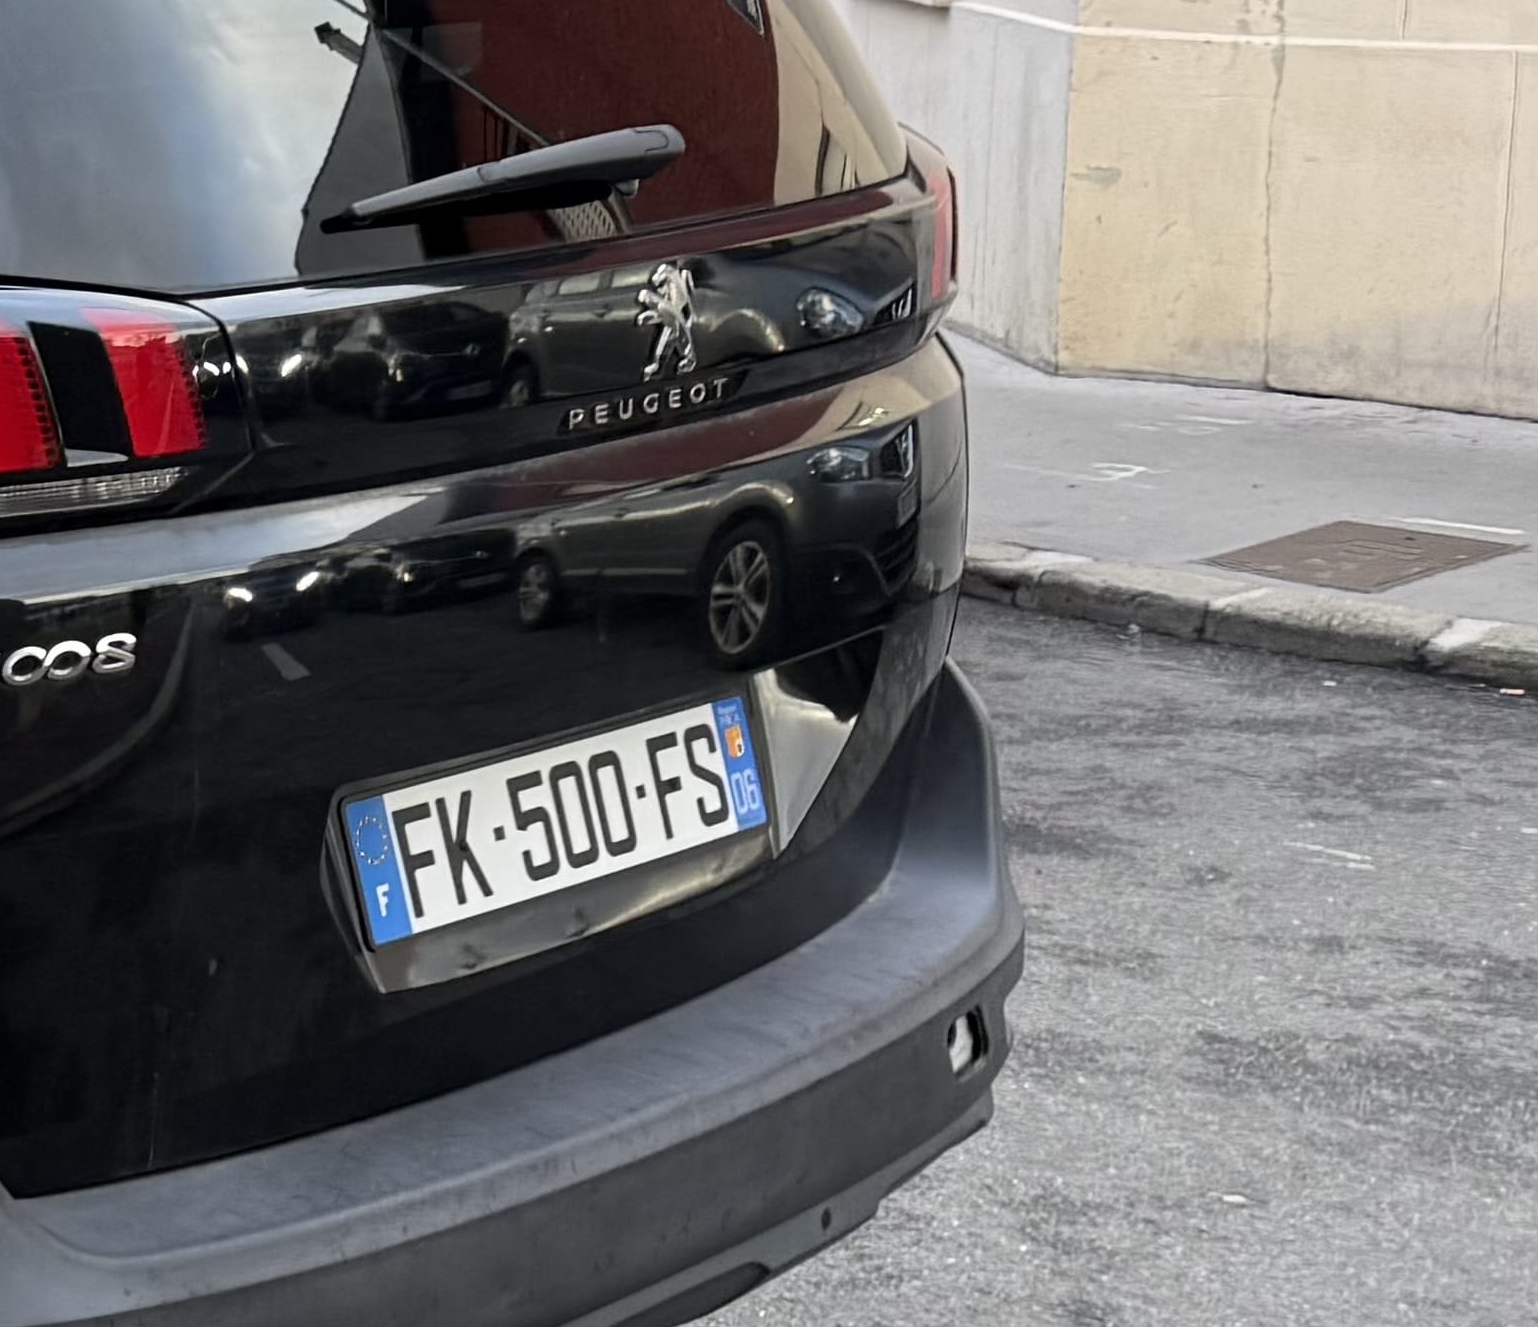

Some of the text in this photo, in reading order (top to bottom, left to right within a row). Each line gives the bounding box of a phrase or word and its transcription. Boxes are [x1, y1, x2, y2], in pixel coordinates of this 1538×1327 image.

[569, 377, 729, 430] PEUGEOT
[730, 768, 761, 815] 06
[375, 883, 389, 917] F
